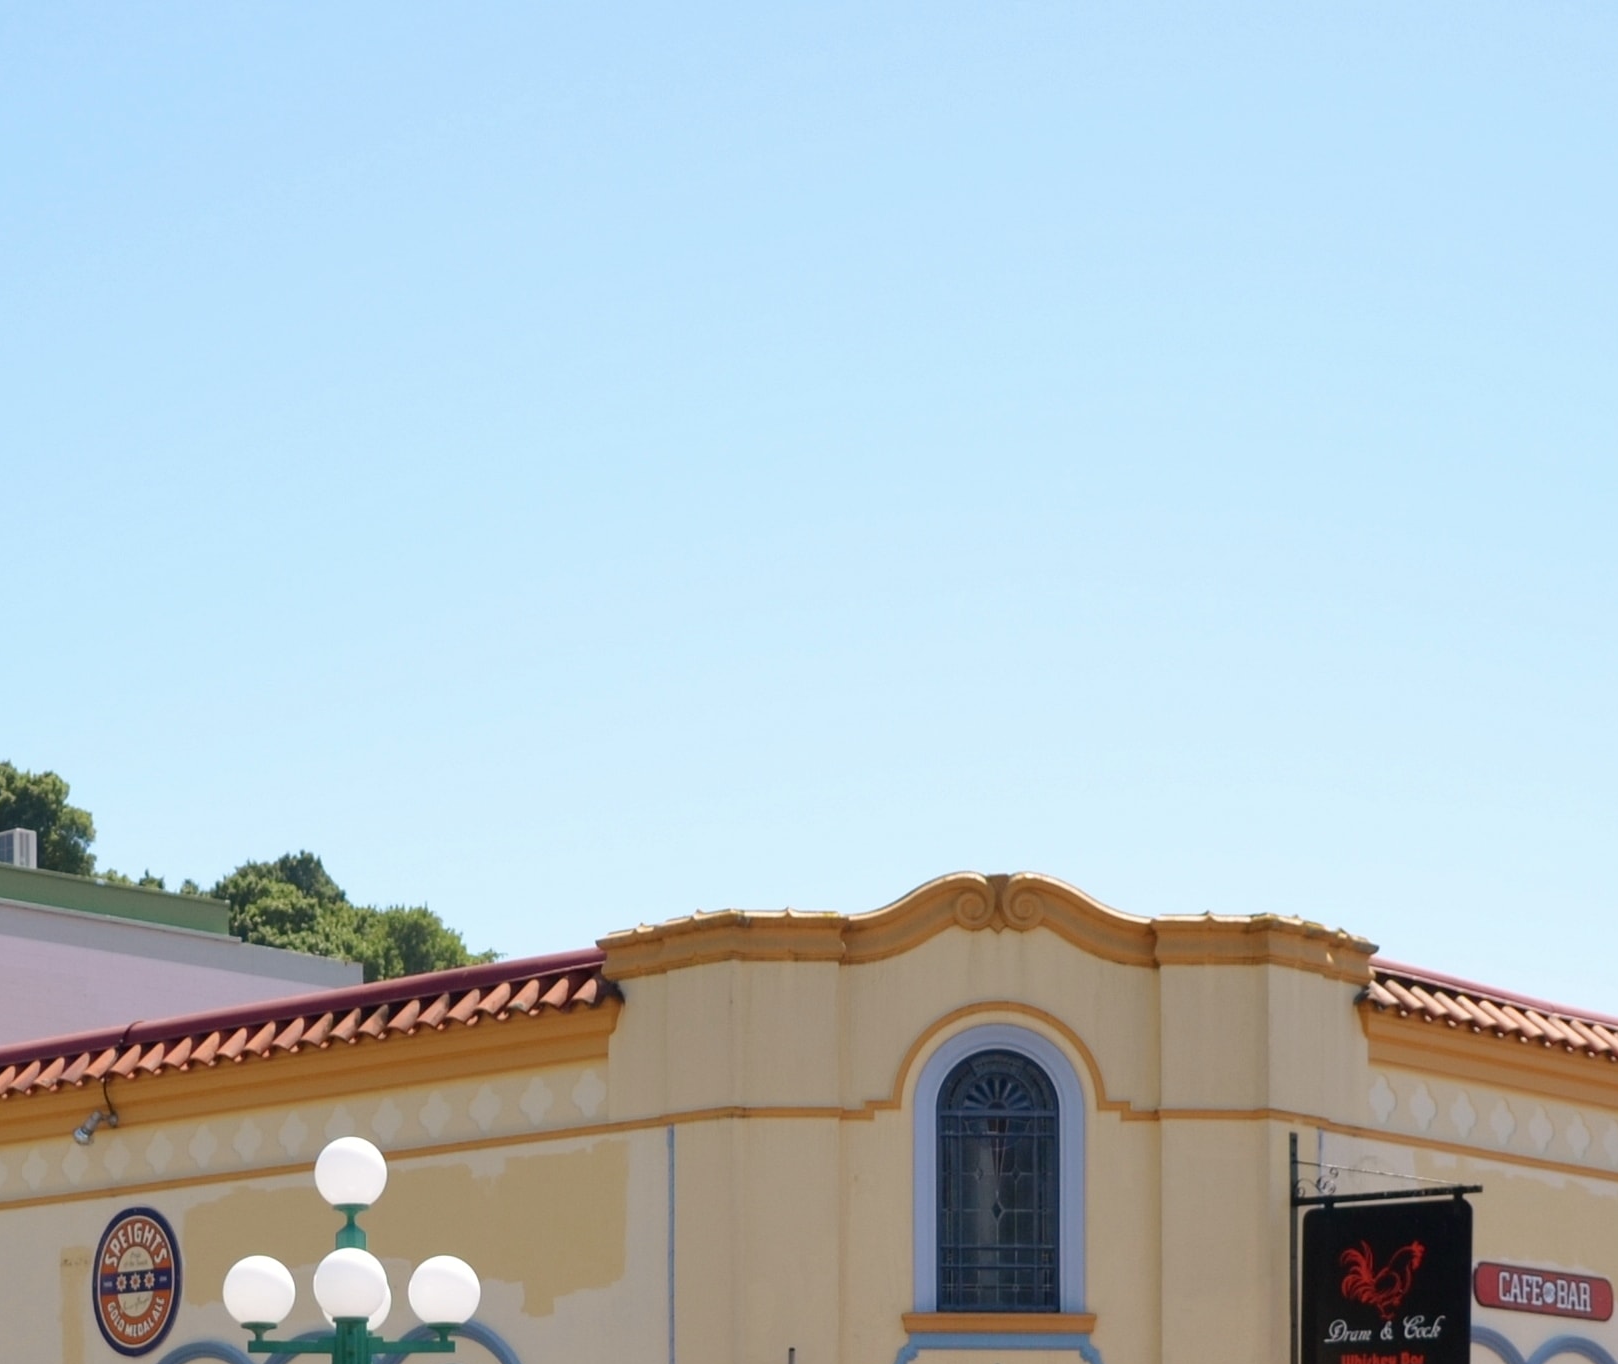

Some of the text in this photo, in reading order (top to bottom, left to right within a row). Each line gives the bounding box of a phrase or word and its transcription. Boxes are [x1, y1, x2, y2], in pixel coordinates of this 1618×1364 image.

[105, 1222, 167, 1266] SPEIGHT'S
[1498, 1271, 1591, 1312] CAFE BAR
[107, 1301, 124, 1333] GOLD
[124, 1318, 154, 1337] MEDAL
[152, 1296, 165, 1323] ALE
[1324, 1315, 1446, 1342] Dram & Cock
